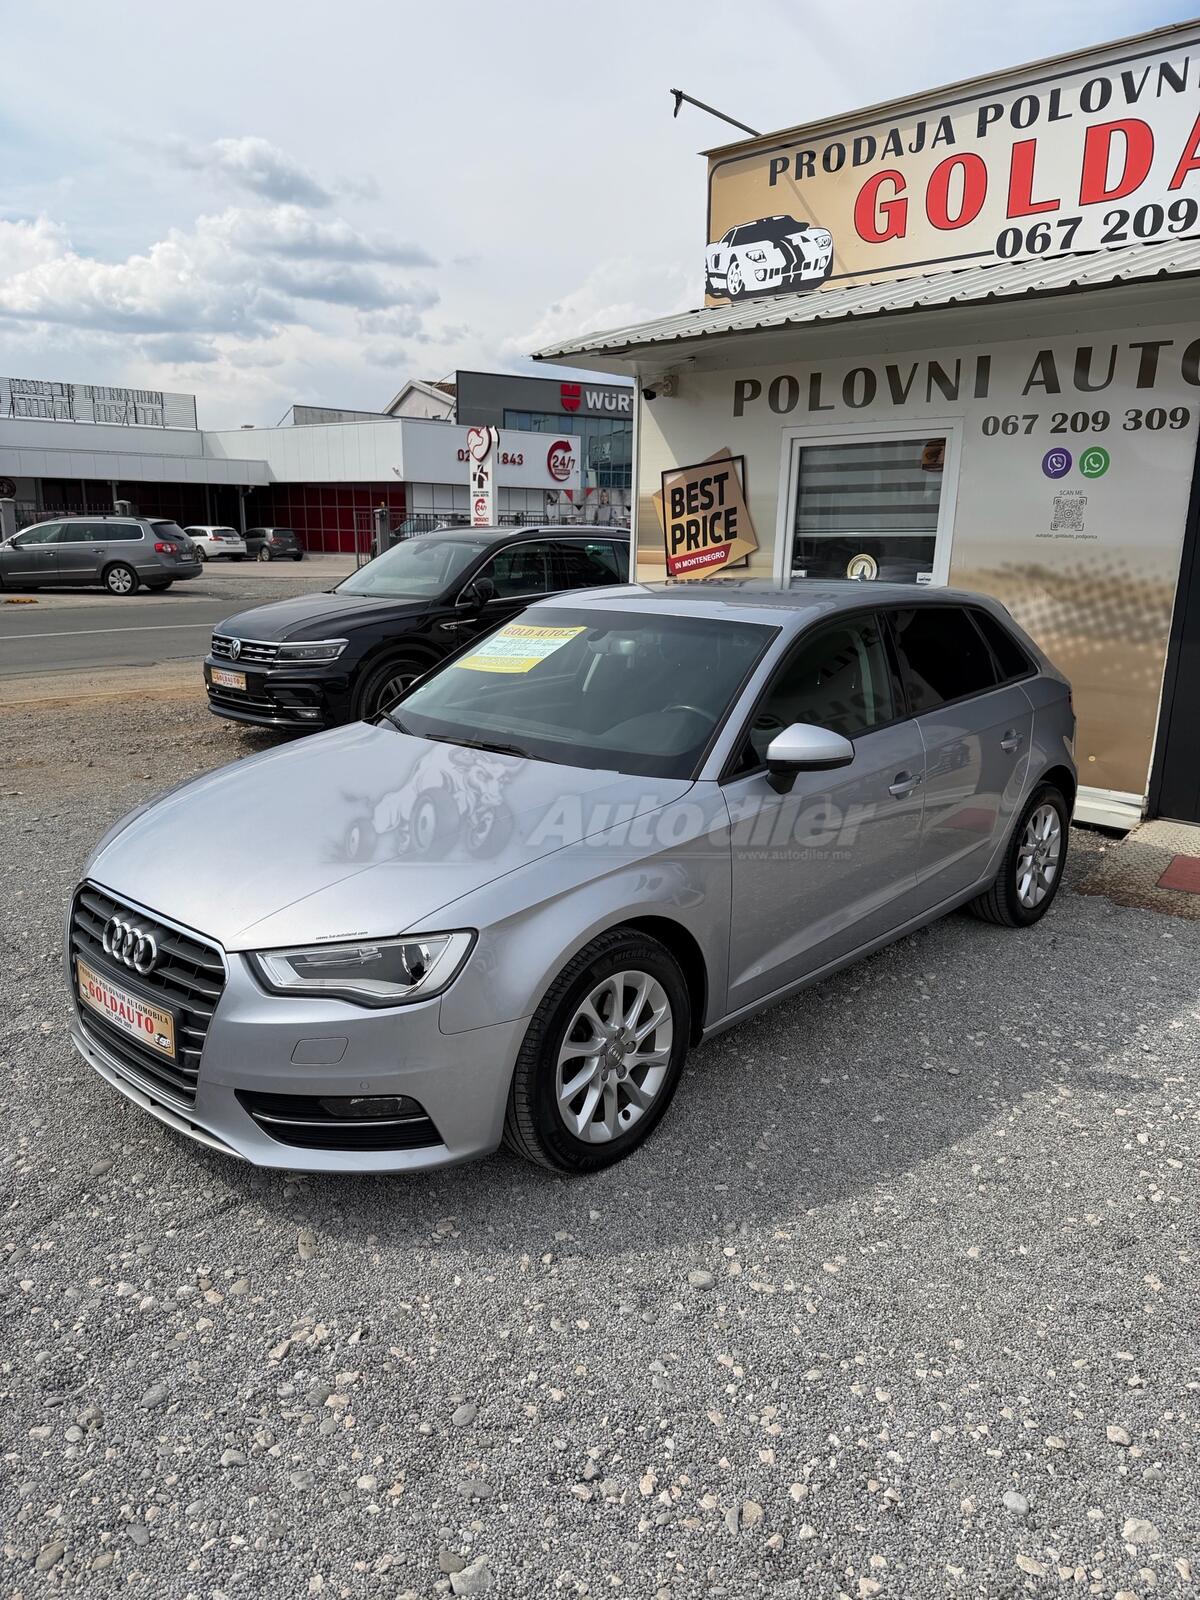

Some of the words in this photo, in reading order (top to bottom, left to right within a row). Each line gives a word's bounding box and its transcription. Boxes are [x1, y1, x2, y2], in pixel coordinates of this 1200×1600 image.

[769, 115, 957, 187] PRODAJA
[976, 56, 1200, 140] POLOVN
[996, 216, 1085, 259] 067
[1101, 198, 1199, 244] 209
[732, 354, 993, 417] POLOVNI
[981, 413, 1039, 437] 067
[1049, 410, 1111, 435] 209
[1122, 407, 1191, 431] 309
[553, 455, 576, 469] 24/7
[671, 472, 729, 520] BEST
[671, 507, 737, 555] PRICE
[675, 561, 682, 569] IN
[682, 550, 725, 568] MONTENEGRO
[504, 627, 533, 636] GOLD
[535, 629, 564, 637] AUTO
[88, 981, 154, 1034] GOLDAUTO
[127, 998, 169, 1025] AUTOMOBILA
